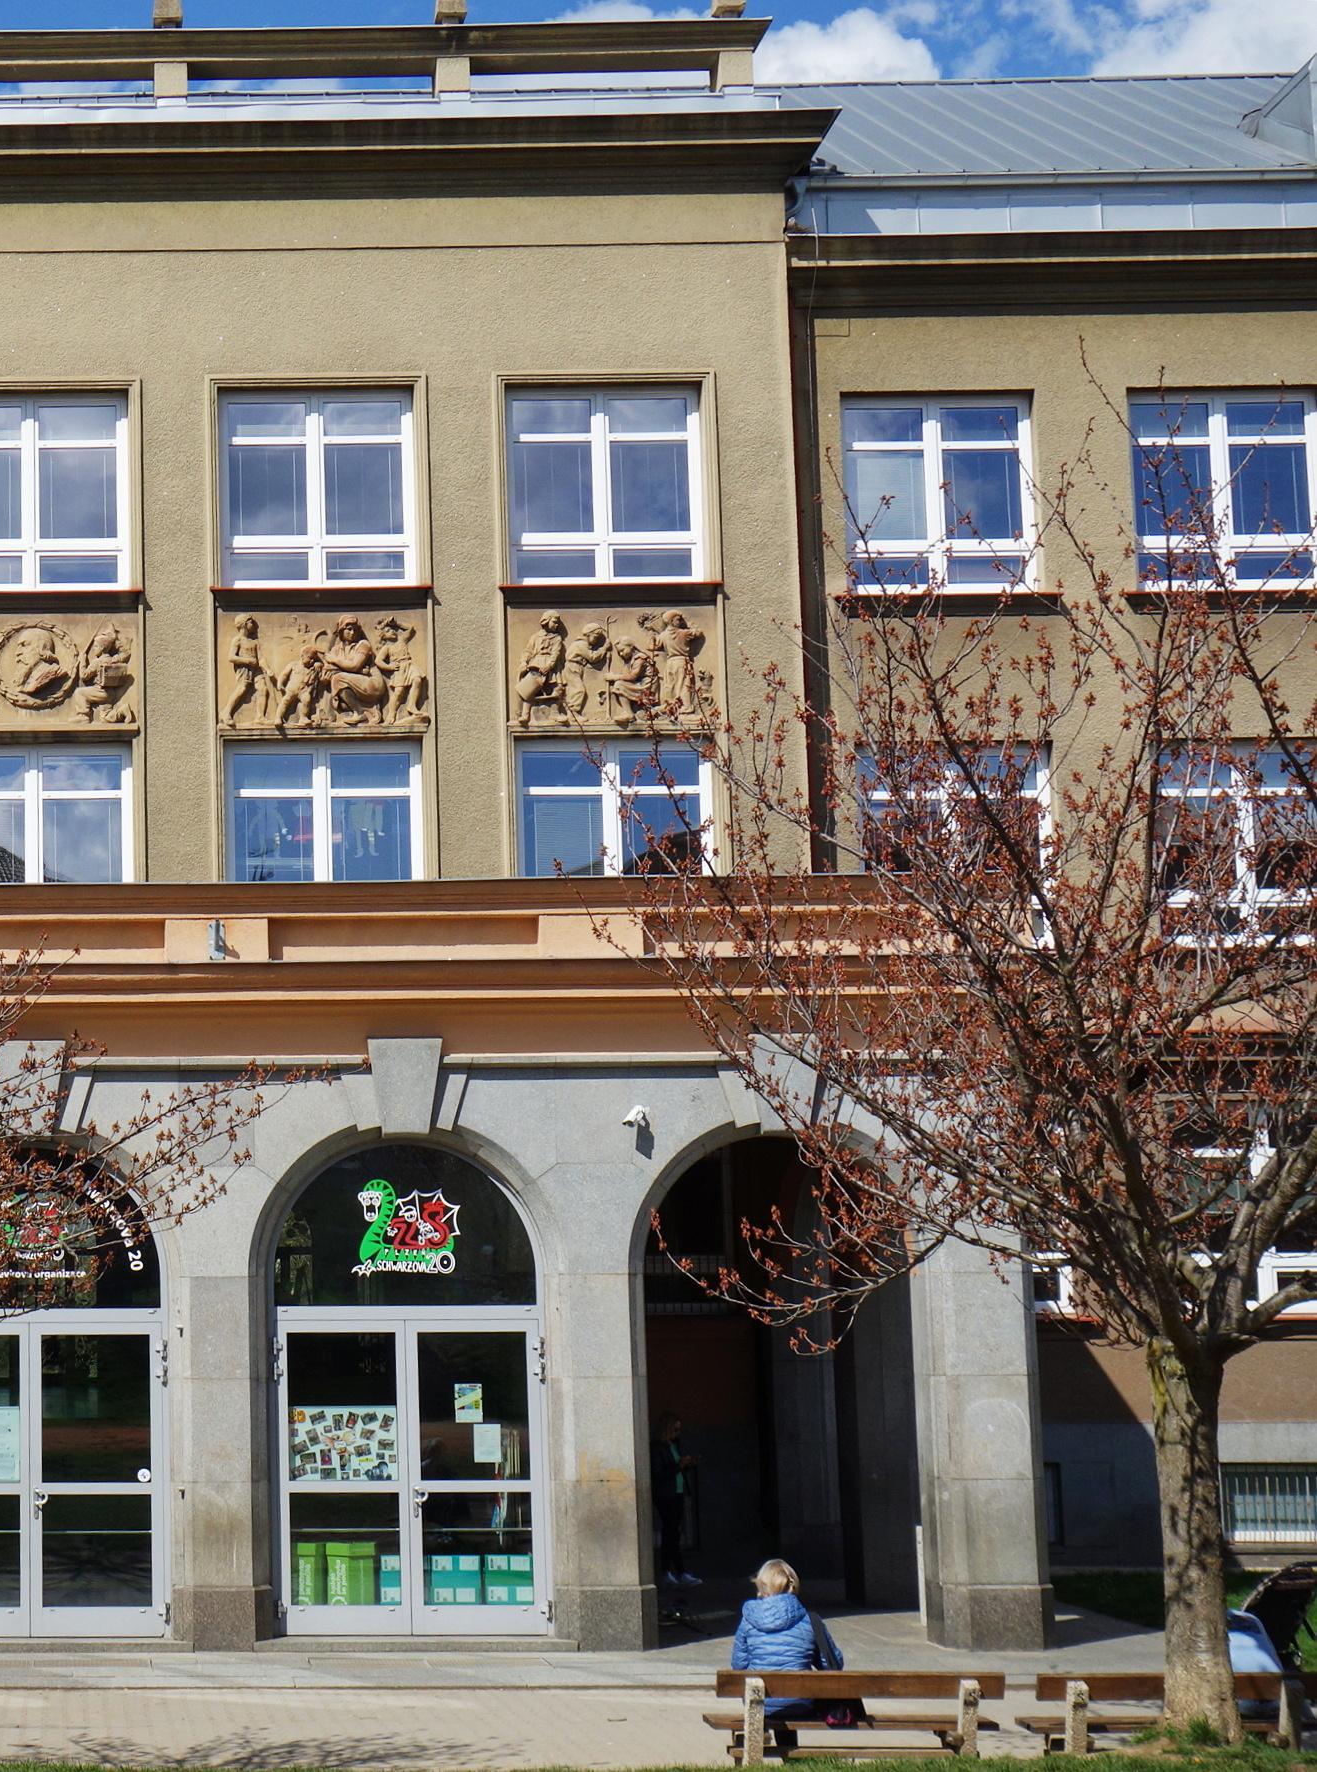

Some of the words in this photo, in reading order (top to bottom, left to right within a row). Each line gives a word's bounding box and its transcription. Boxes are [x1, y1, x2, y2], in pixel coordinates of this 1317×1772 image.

[127, 1249, 144, 1272] 20
[377, 1260, 427, 1273] SCHWARZOVA
[426, 1250, 456, 1274] 20
